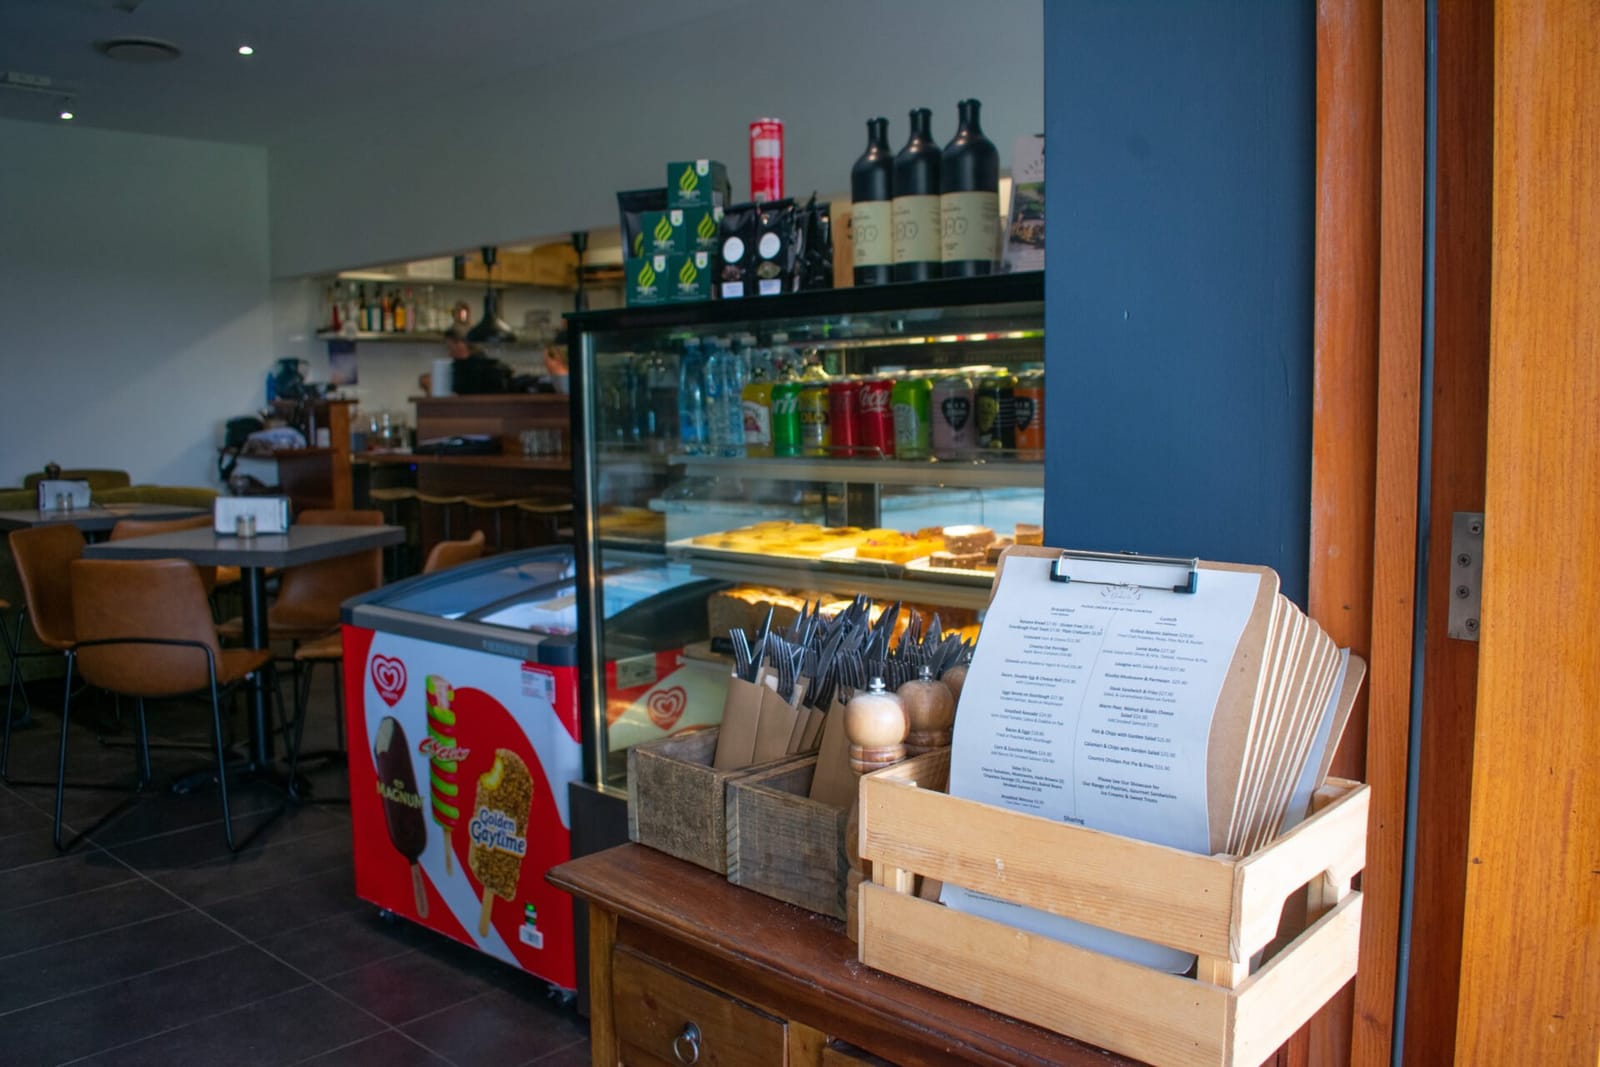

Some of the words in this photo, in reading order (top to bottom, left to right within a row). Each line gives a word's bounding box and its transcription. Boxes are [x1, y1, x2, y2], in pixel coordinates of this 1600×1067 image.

[376, 781, 424, 808] MAGNUM
[480, 809, 515, 832] Golden
[1064, 815, 1084, 825] Sharing
[471, 820, 525, 853] Gaytime
